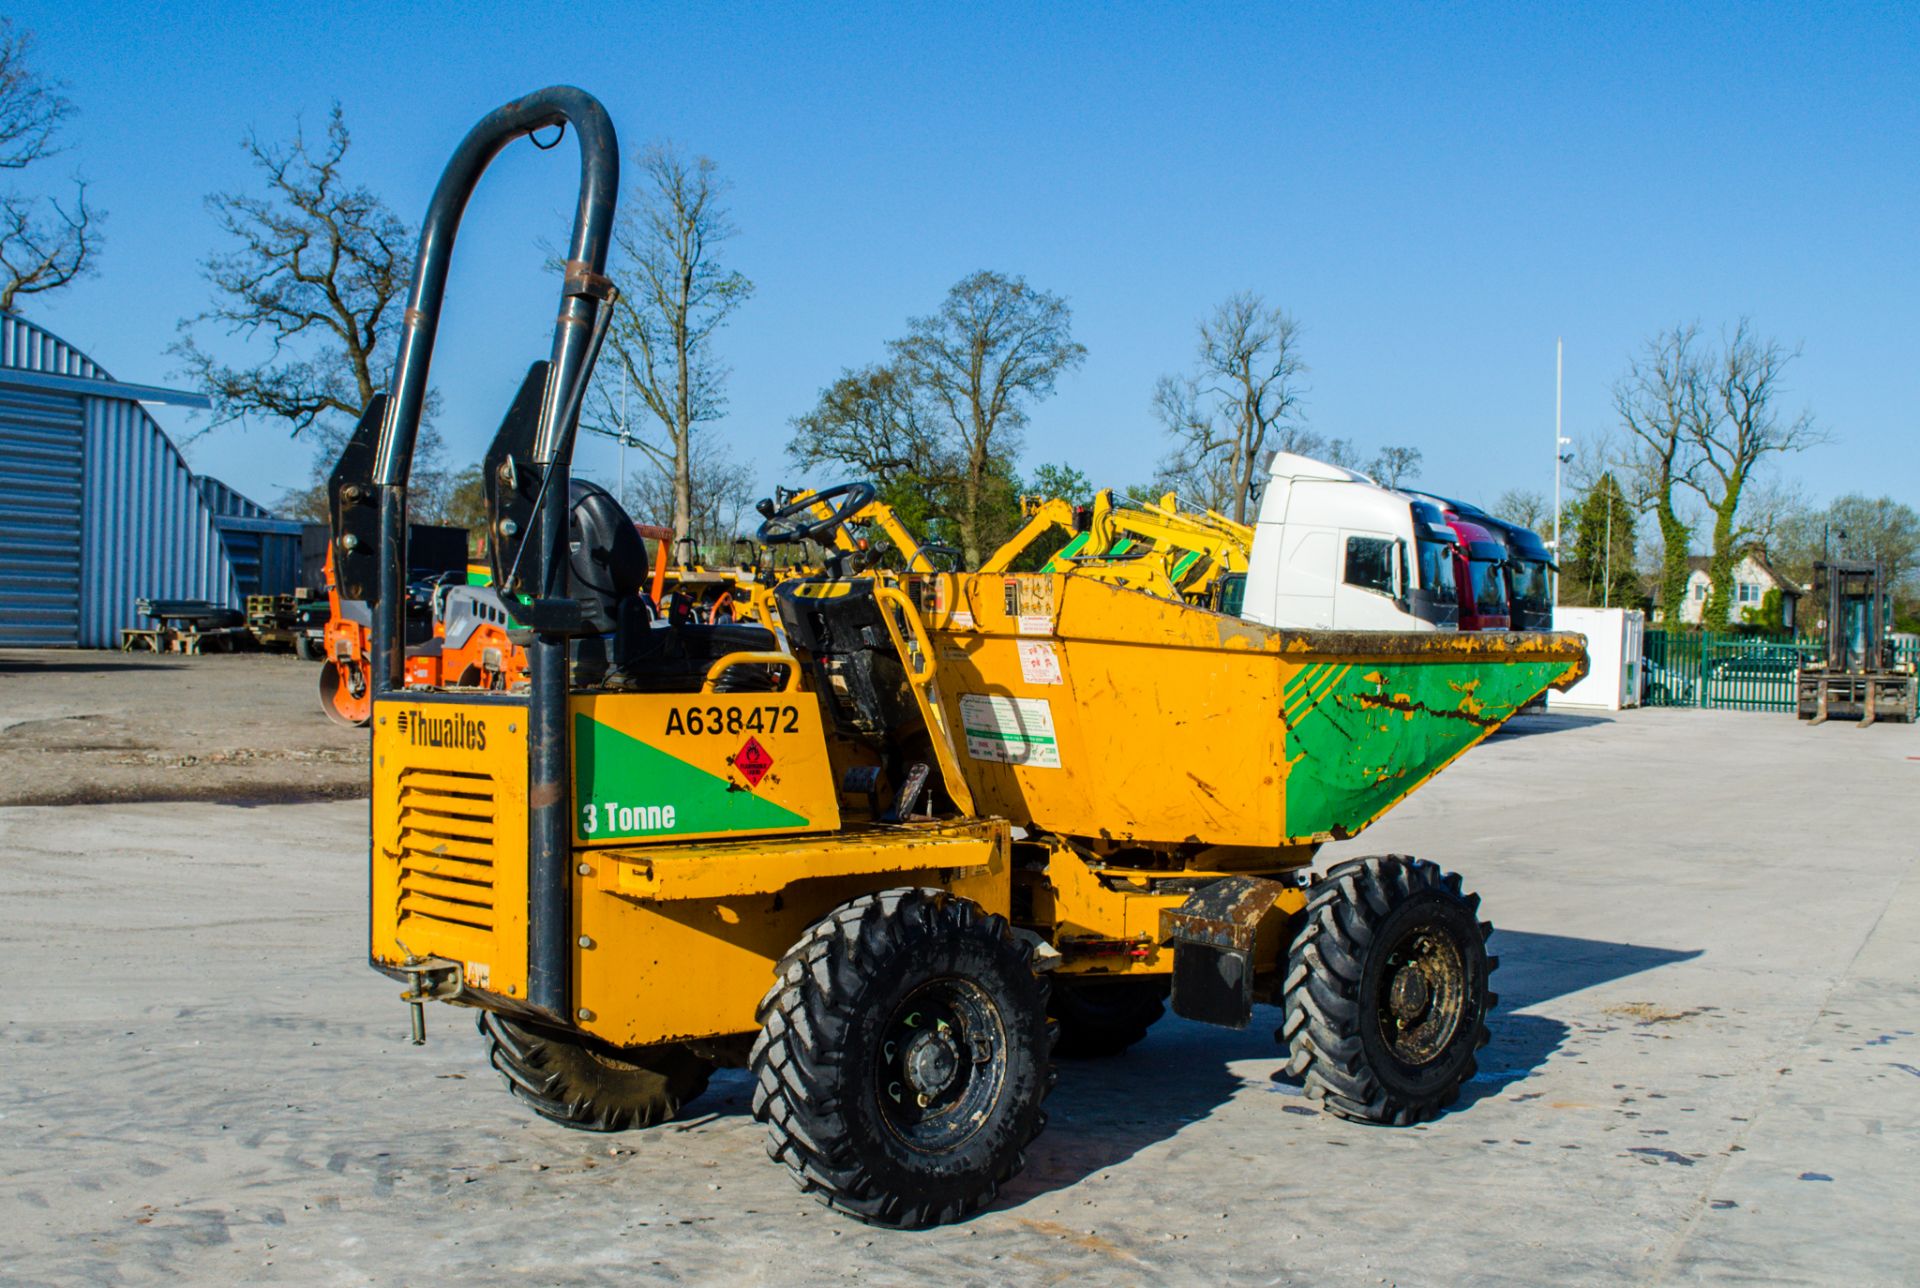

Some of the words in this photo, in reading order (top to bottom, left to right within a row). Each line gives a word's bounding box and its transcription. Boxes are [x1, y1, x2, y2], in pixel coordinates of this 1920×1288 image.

[409, 710, 487, 751] Thwaites
[665, 706, 799, 735] A638472
[582, 803, 598, 833] 3
[604, 802, 676, 832] Tonne
